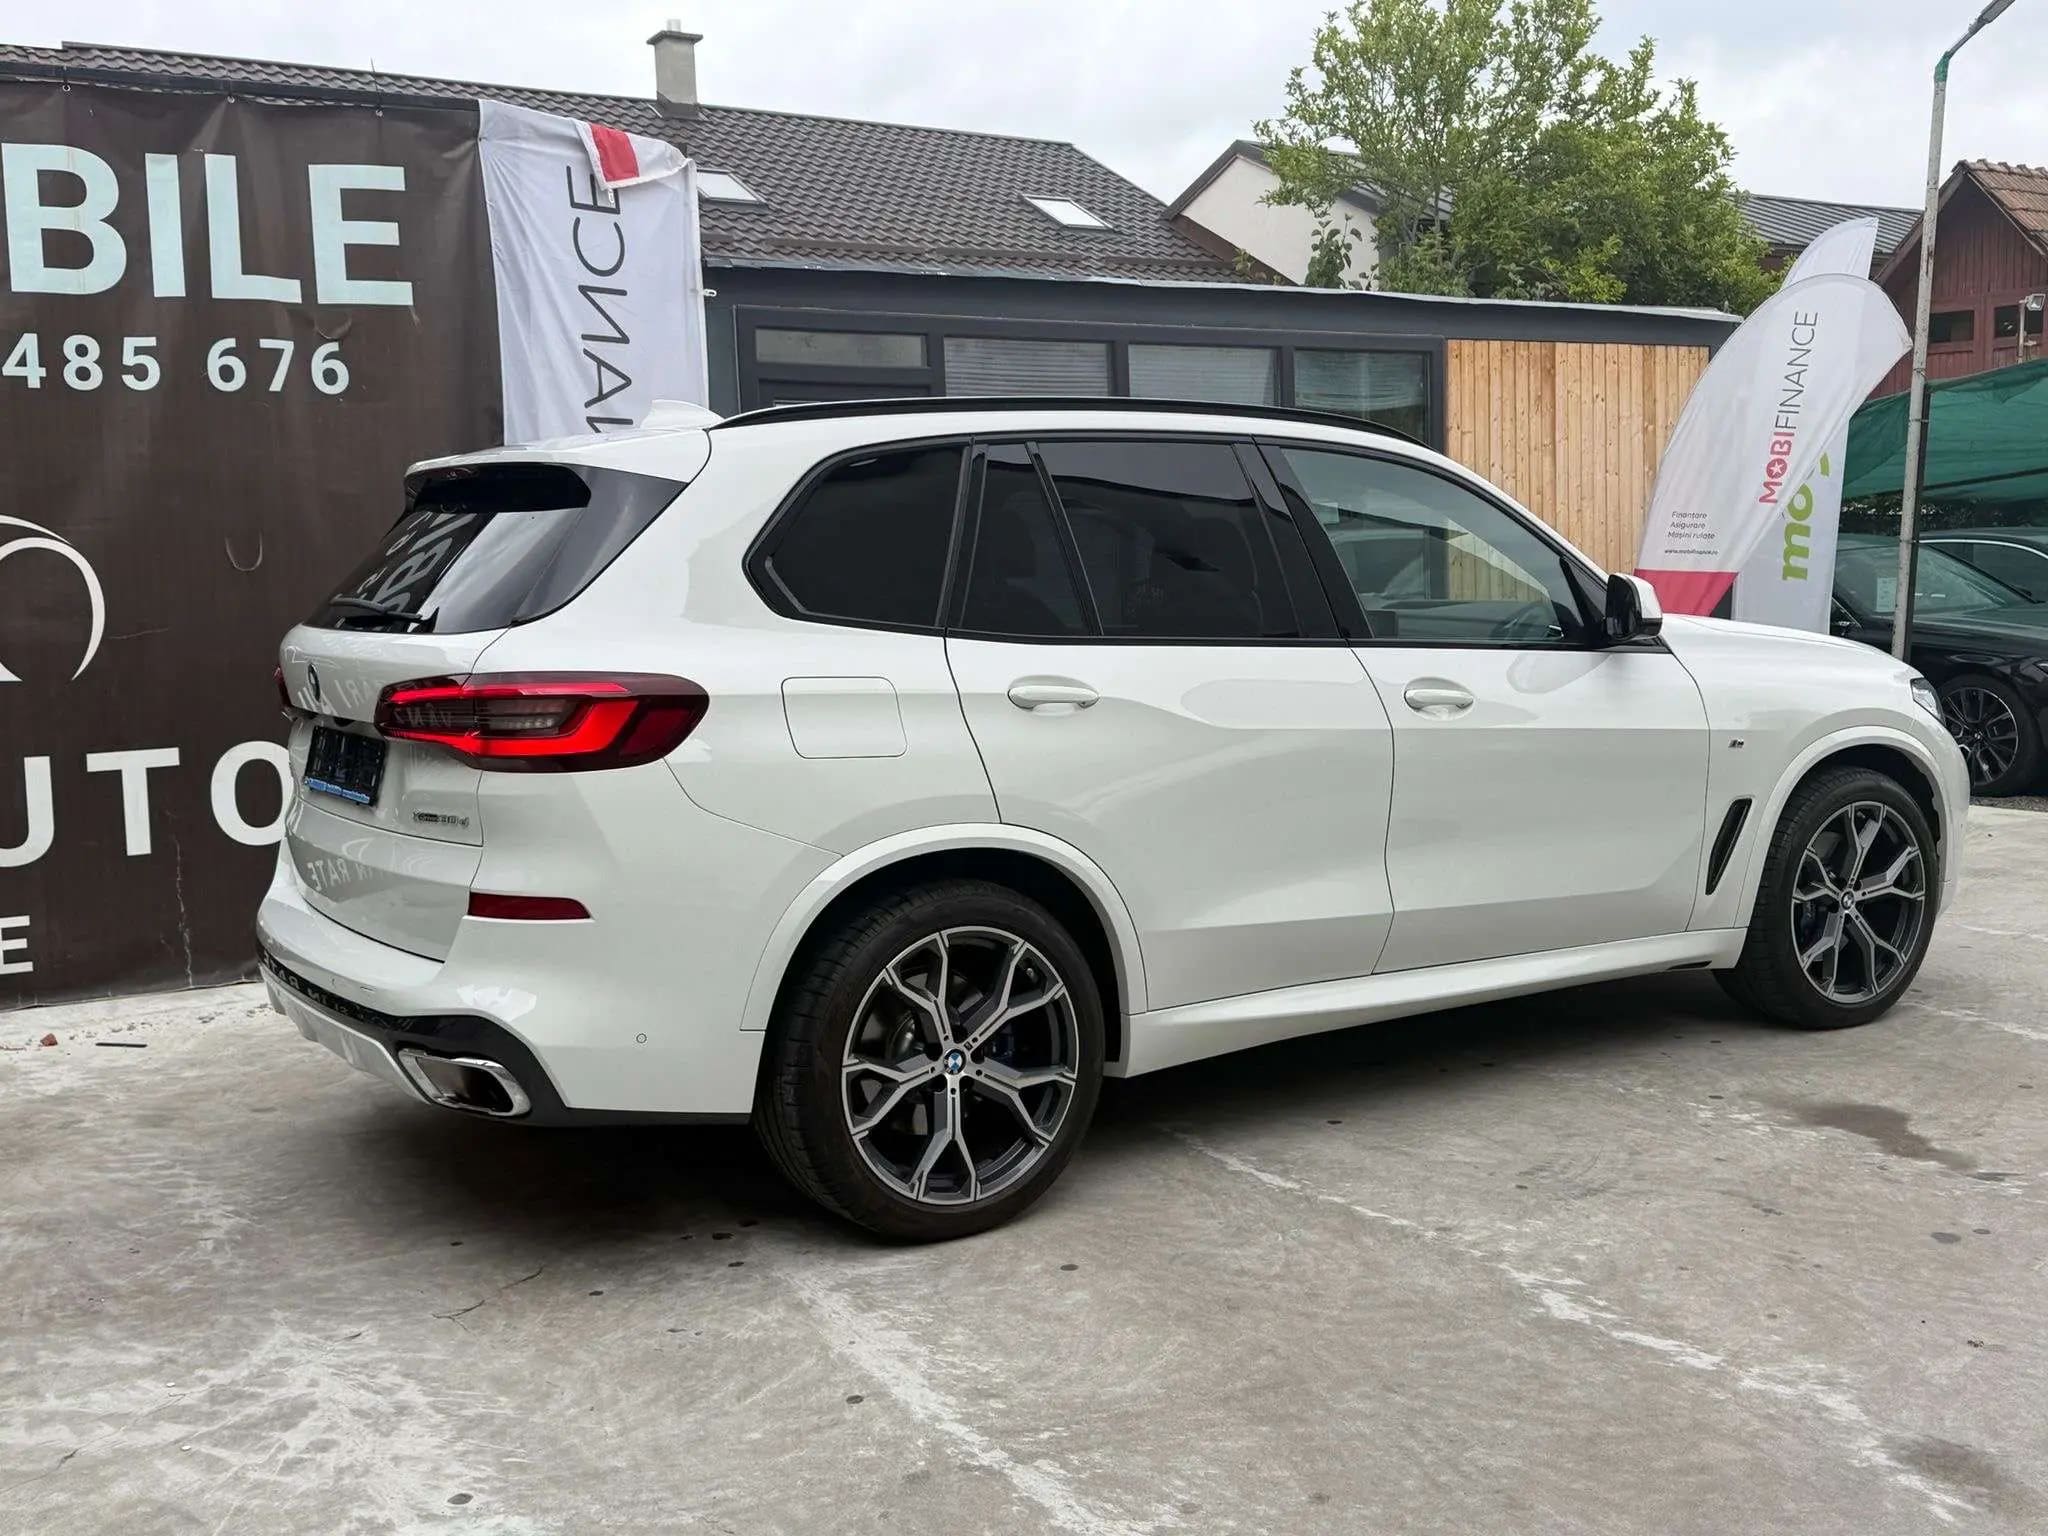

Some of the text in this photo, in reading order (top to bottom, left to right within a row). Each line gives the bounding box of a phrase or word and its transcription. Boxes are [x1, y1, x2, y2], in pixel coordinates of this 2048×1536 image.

[2, 143, 413, 306] BILE
[2, 333, 350, 395] 485 676
[1758, 311, 1818, 503] MOBIFINANCE
[0, 914, 34, 976] E
